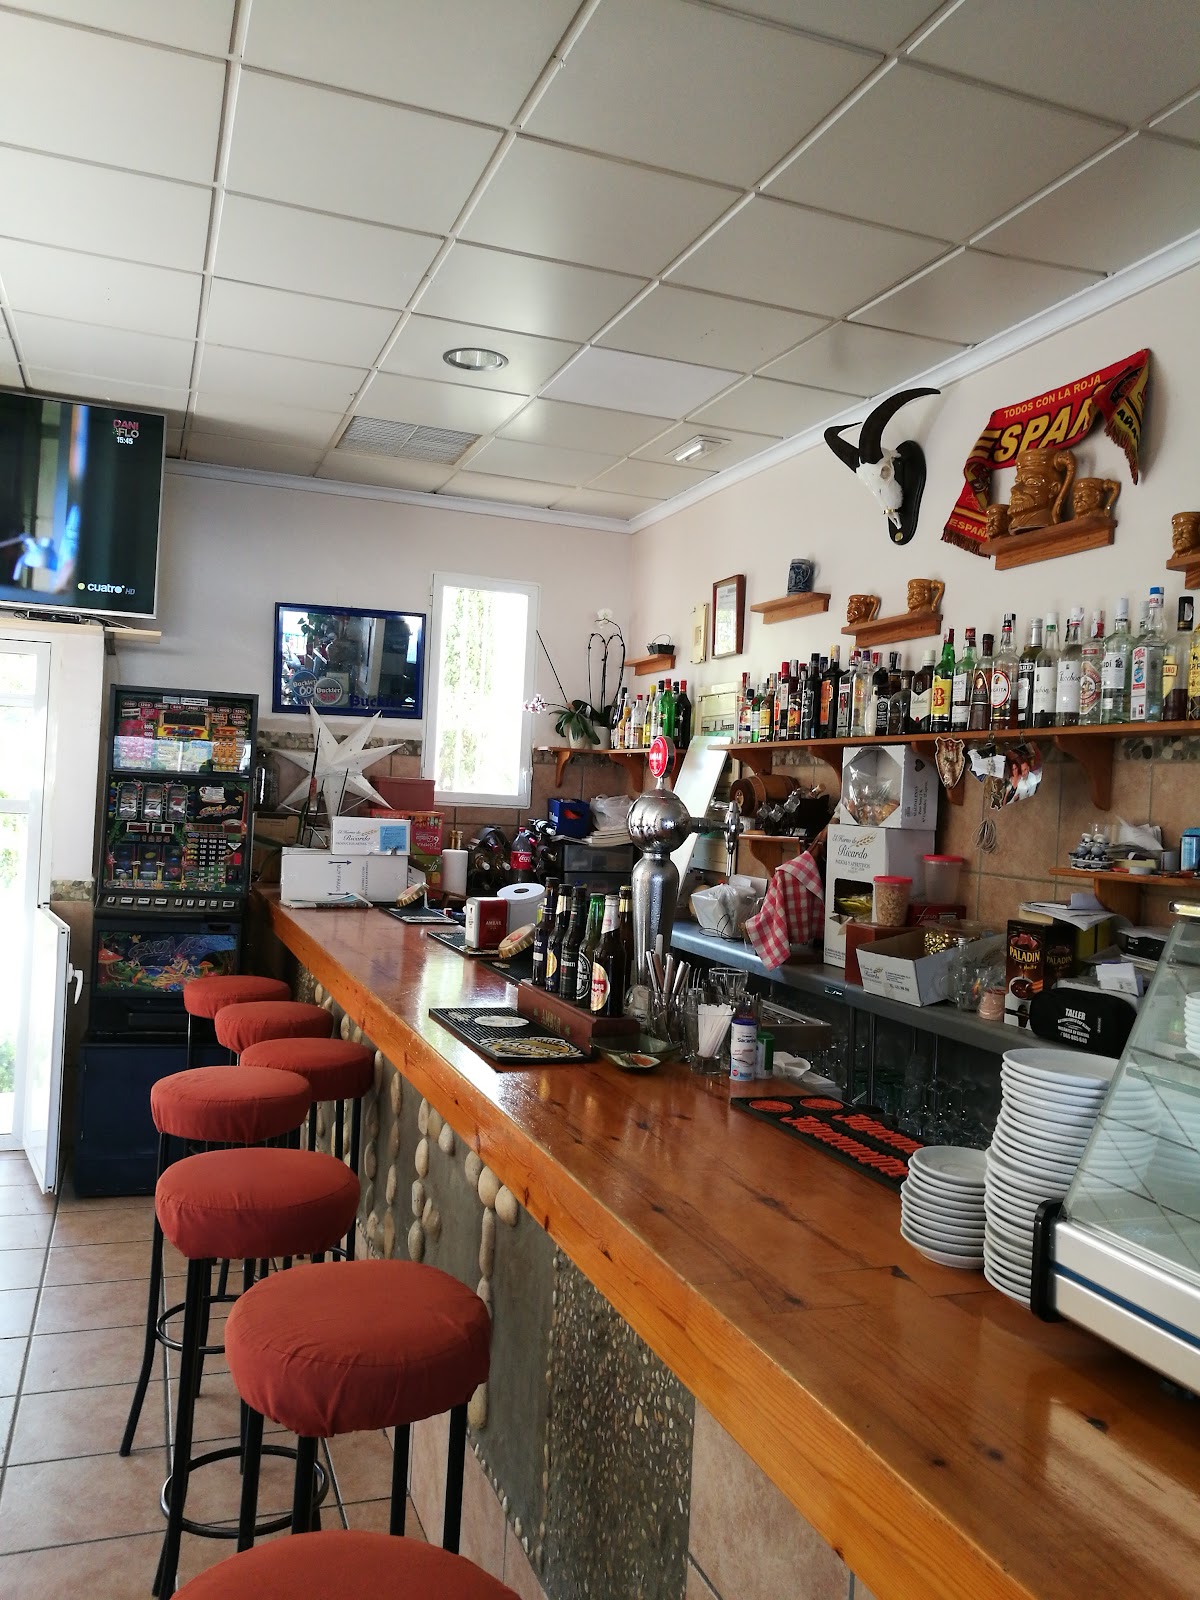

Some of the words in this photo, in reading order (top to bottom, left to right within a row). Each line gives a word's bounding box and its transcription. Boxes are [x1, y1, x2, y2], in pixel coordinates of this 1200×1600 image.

[1004, 402, 1033, 419] TODOS
[1036, 394, 1056, 408] CON
[1058, 390, 1071, 400] LA
[1074, 374, 1101, 394] ROJA
[112, 420, 139, 430] DANI
[116, 436, 133, 444] 15:45
[948, 518, 988, 538] ESPAÑ
[87, 582, 124, 594] cuatro
[838, 844, 868, 859] Ricardo
[1009, 946, 1040, 962] PALADIN
[1046, 955, 1072, 964] PALADIN
[1065, 1008, 1086, 1020] TALLER
